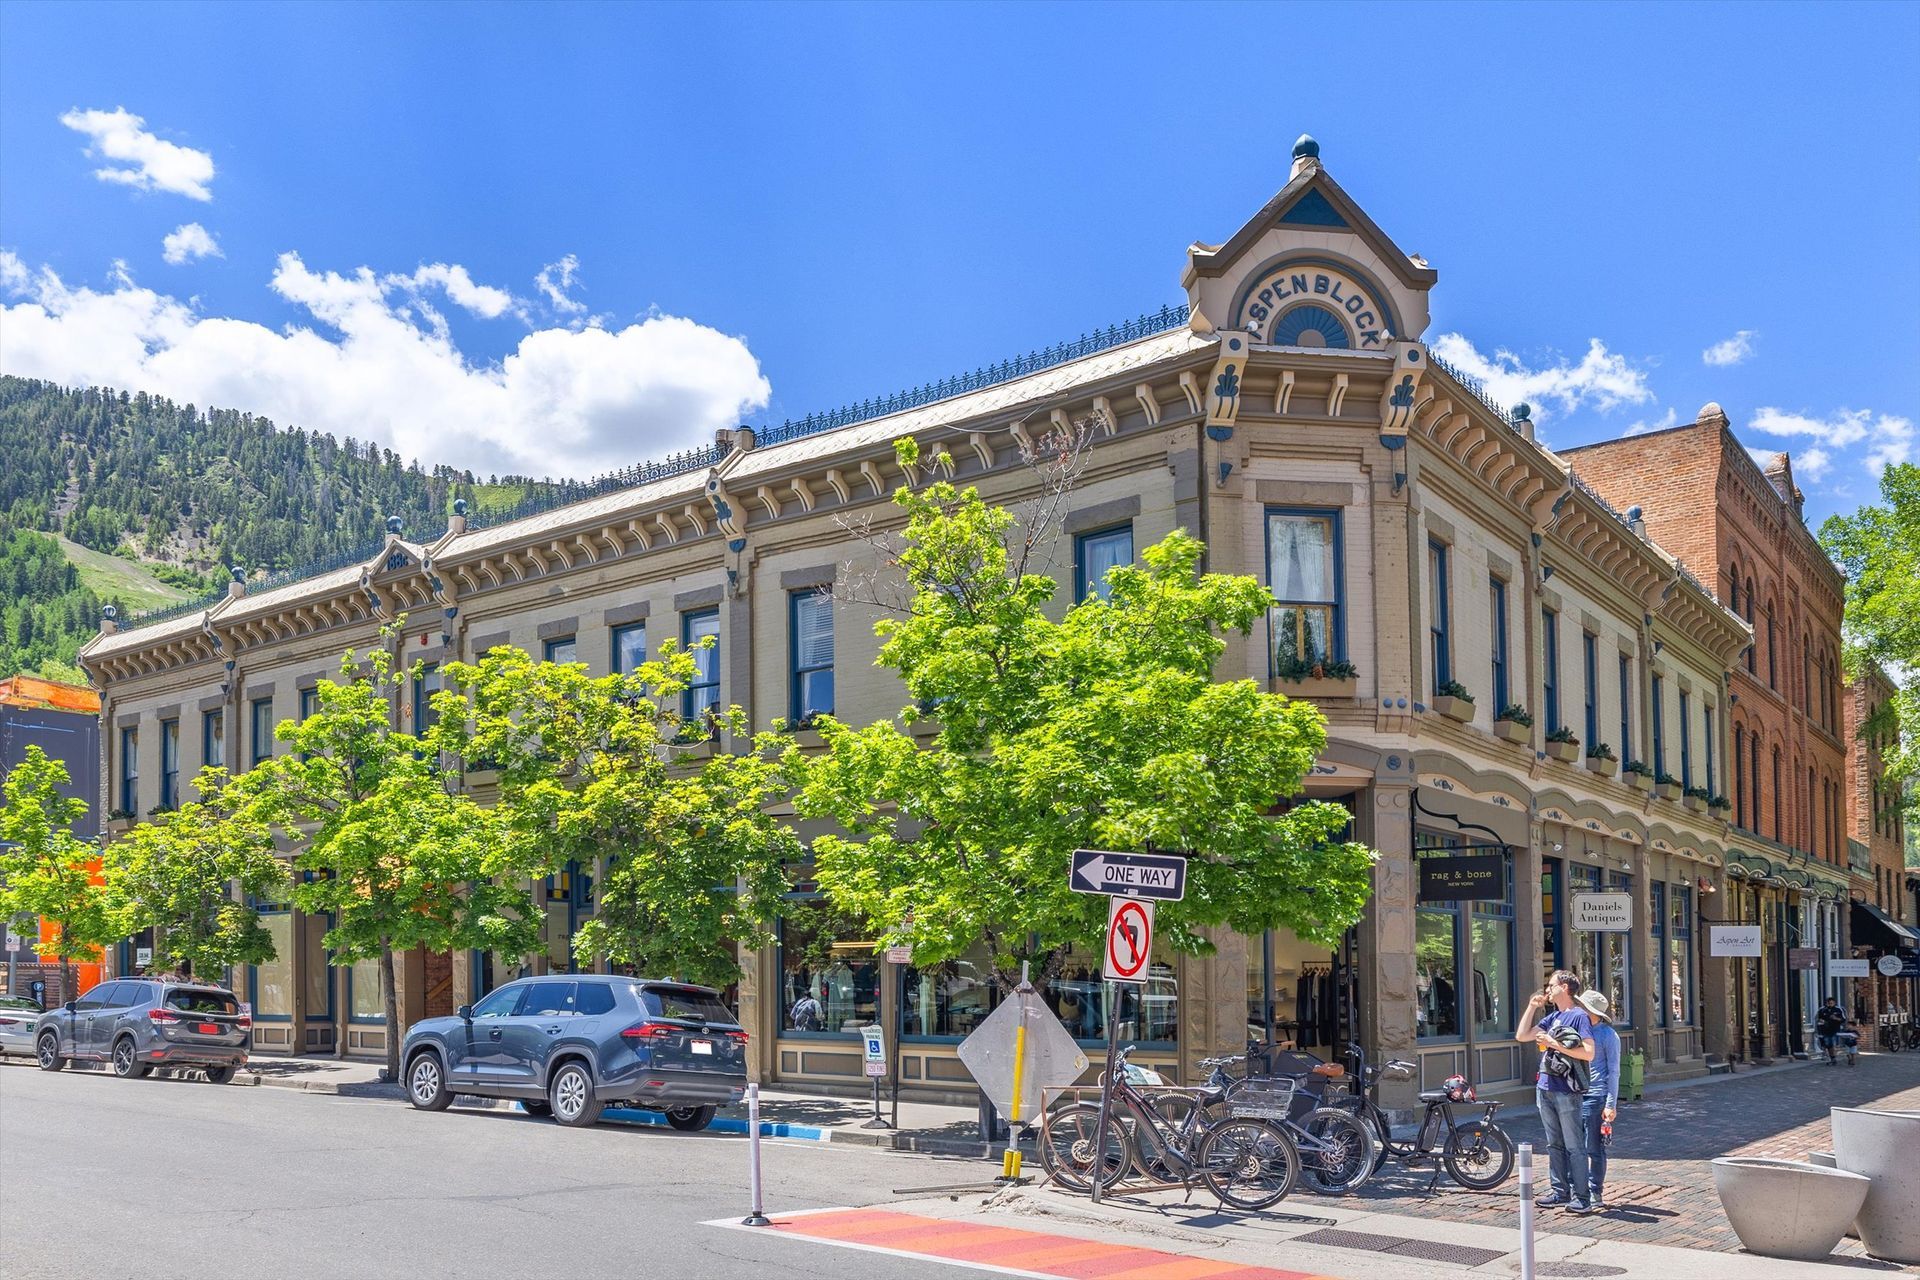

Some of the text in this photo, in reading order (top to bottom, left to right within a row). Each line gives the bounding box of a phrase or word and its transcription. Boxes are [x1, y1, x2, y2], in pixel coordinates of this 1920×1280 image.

[1314, 274, 1380, 347] BLOCK
[1105, 866, 1171, 885] ONE WAY
[1431, 870, 1492, 880] rag & bone
[1583, 901, 1623, 911] Daniels
[1579, 913, 1627, 925] Antiques
